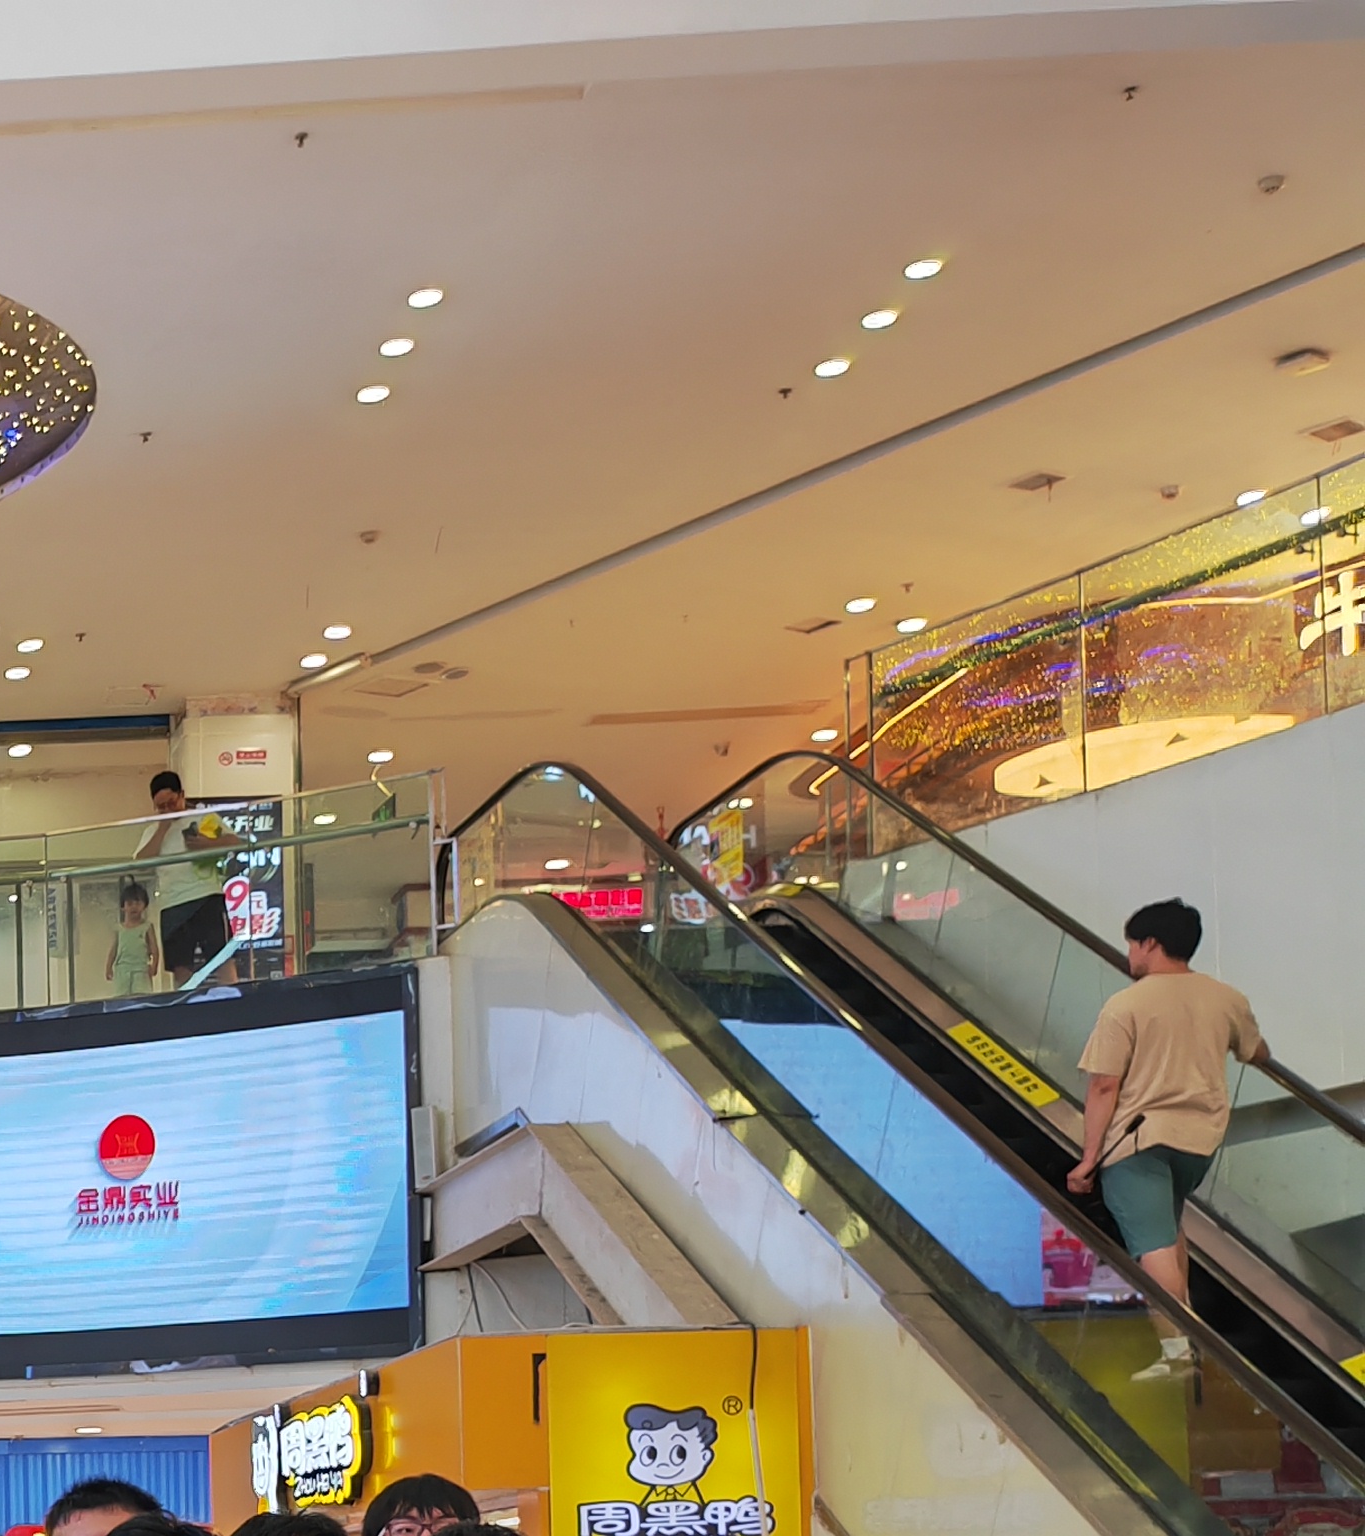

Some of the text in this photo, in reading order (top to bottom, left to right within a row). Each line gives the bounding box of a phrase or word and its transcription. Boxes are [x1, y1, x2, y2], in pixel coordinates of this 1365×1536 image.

[77, 1180, 180, 1214] 金鼎实业
[280, 1404, 353, 1477] 周黑鸭
